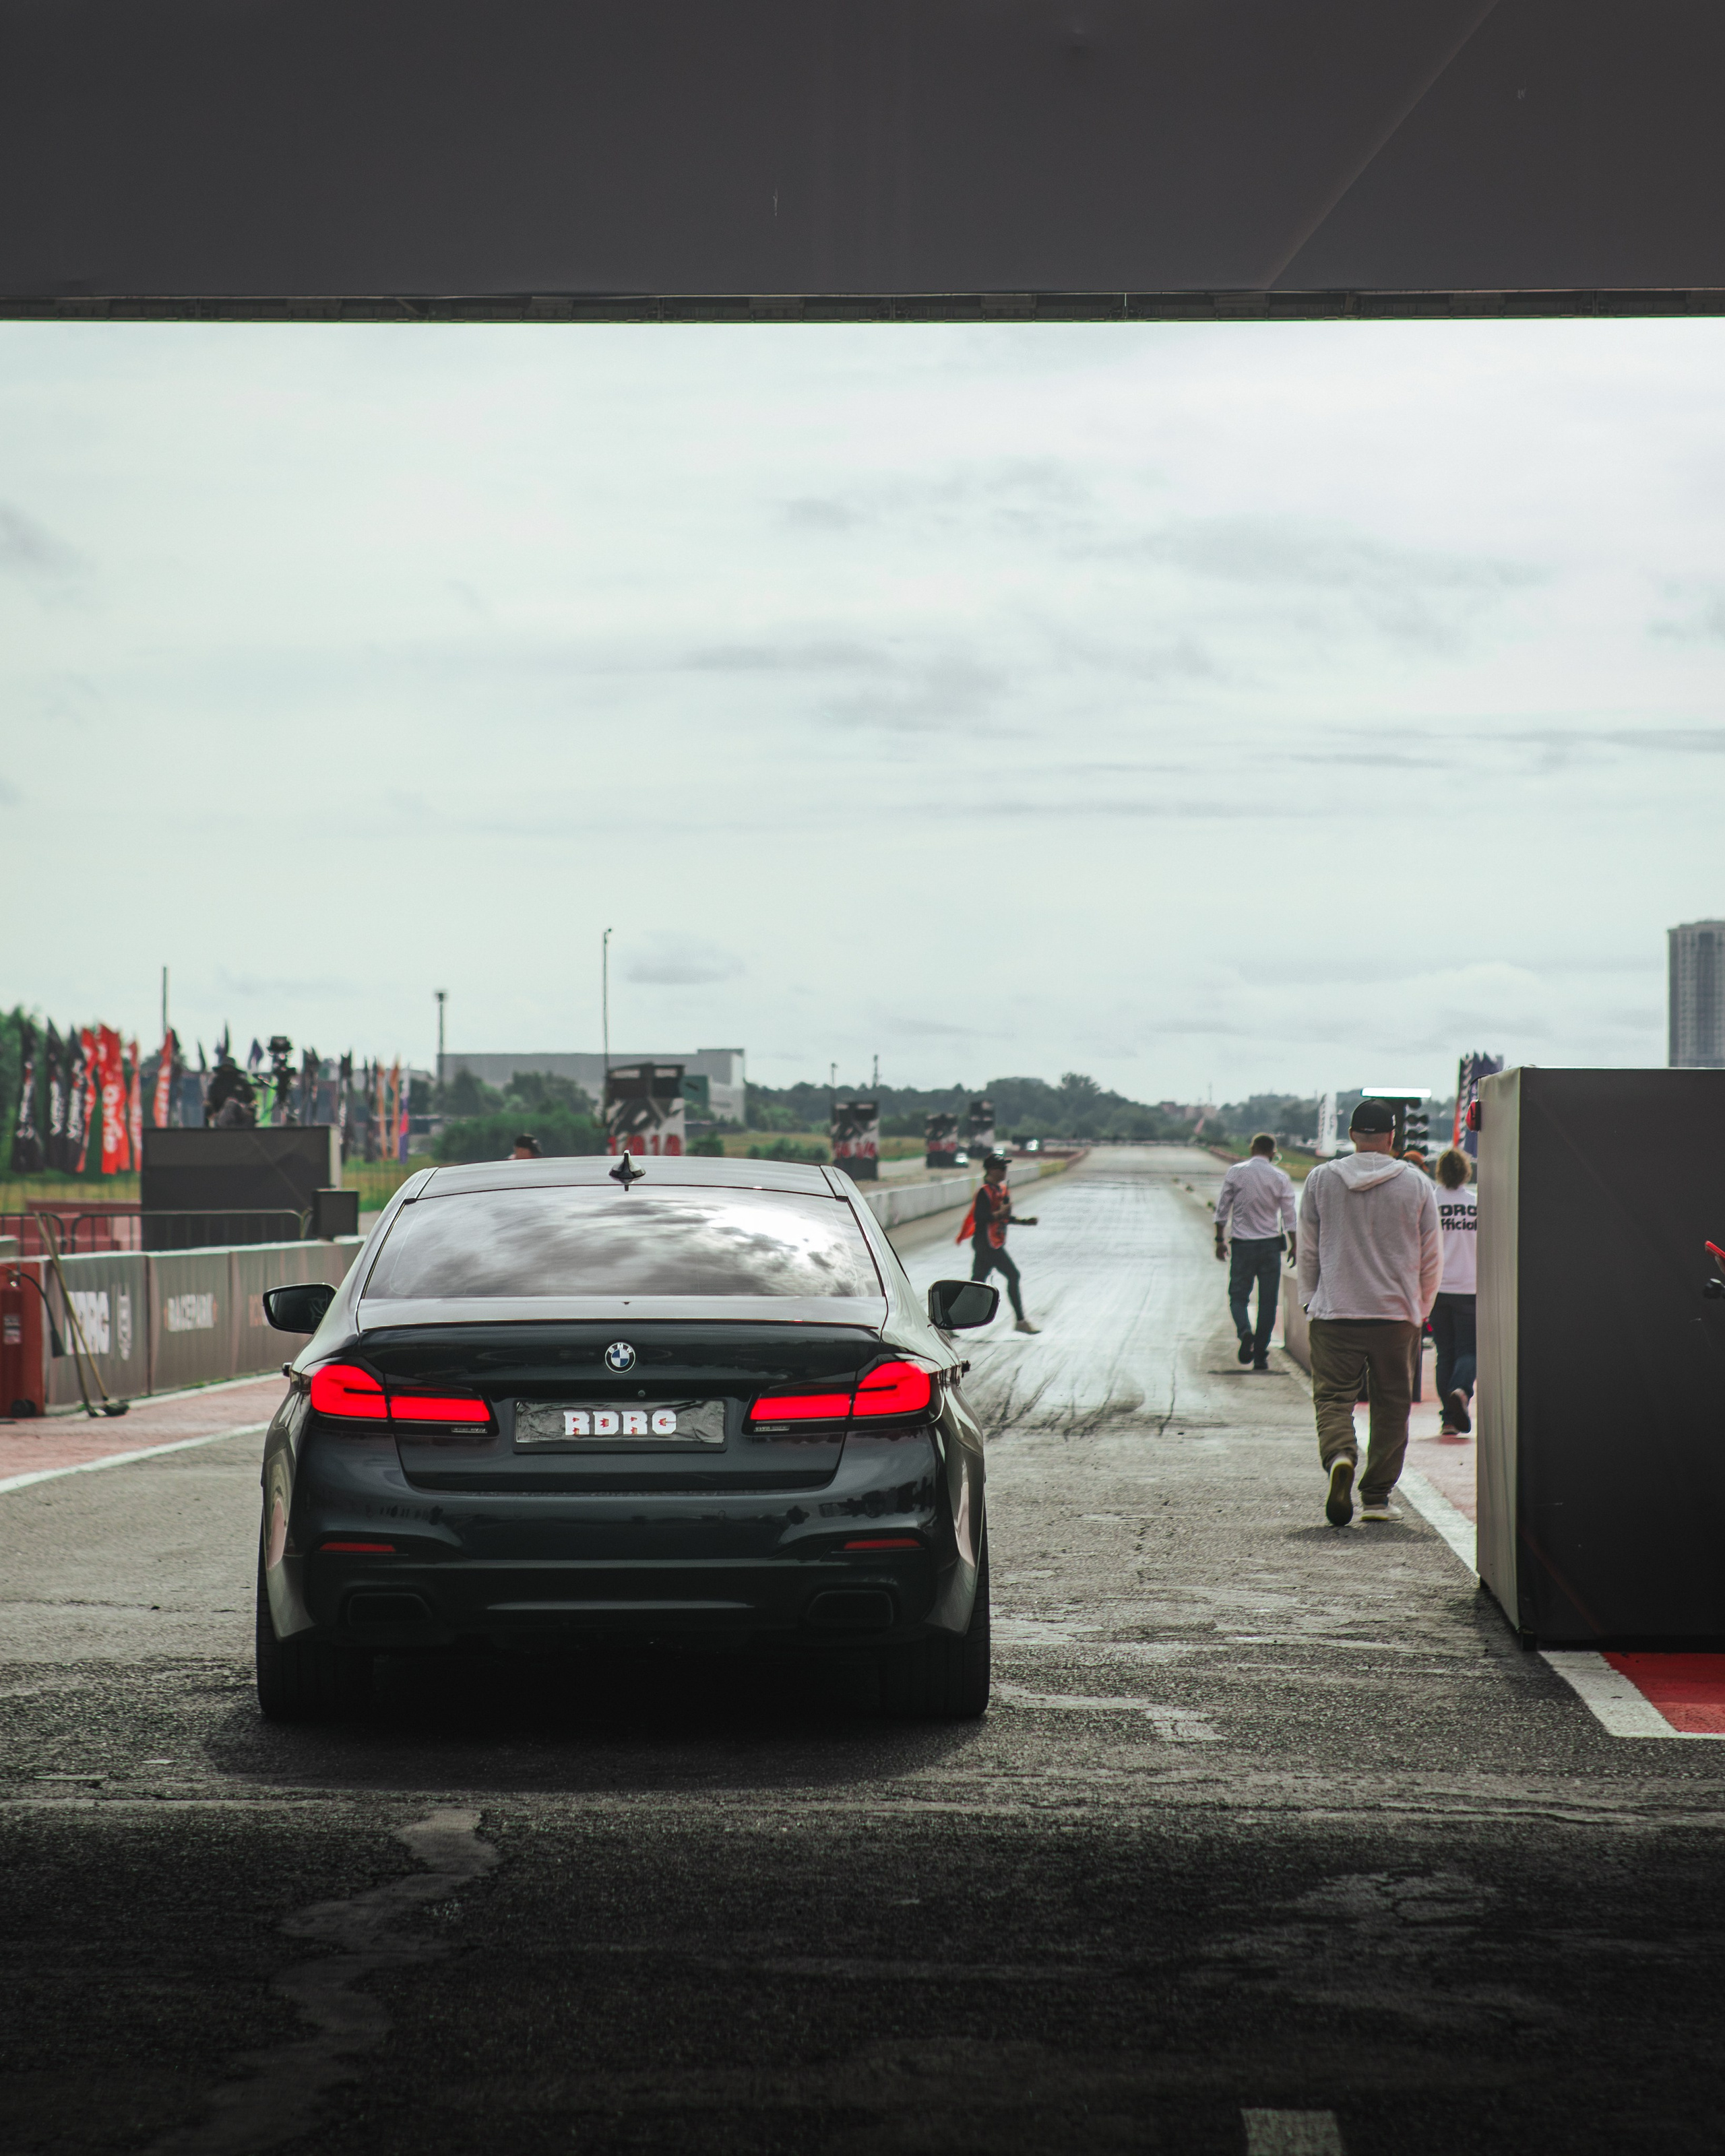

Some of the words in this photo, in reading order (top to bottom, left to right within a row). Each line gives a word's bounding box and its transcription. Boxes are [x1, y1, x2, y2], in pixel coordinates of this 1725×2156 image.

[1439, 1204, 1477, 1216] DRC
[1441, 1217, 1477, 1231] fficial
[563, 1410, 677, 1435] RDRC
